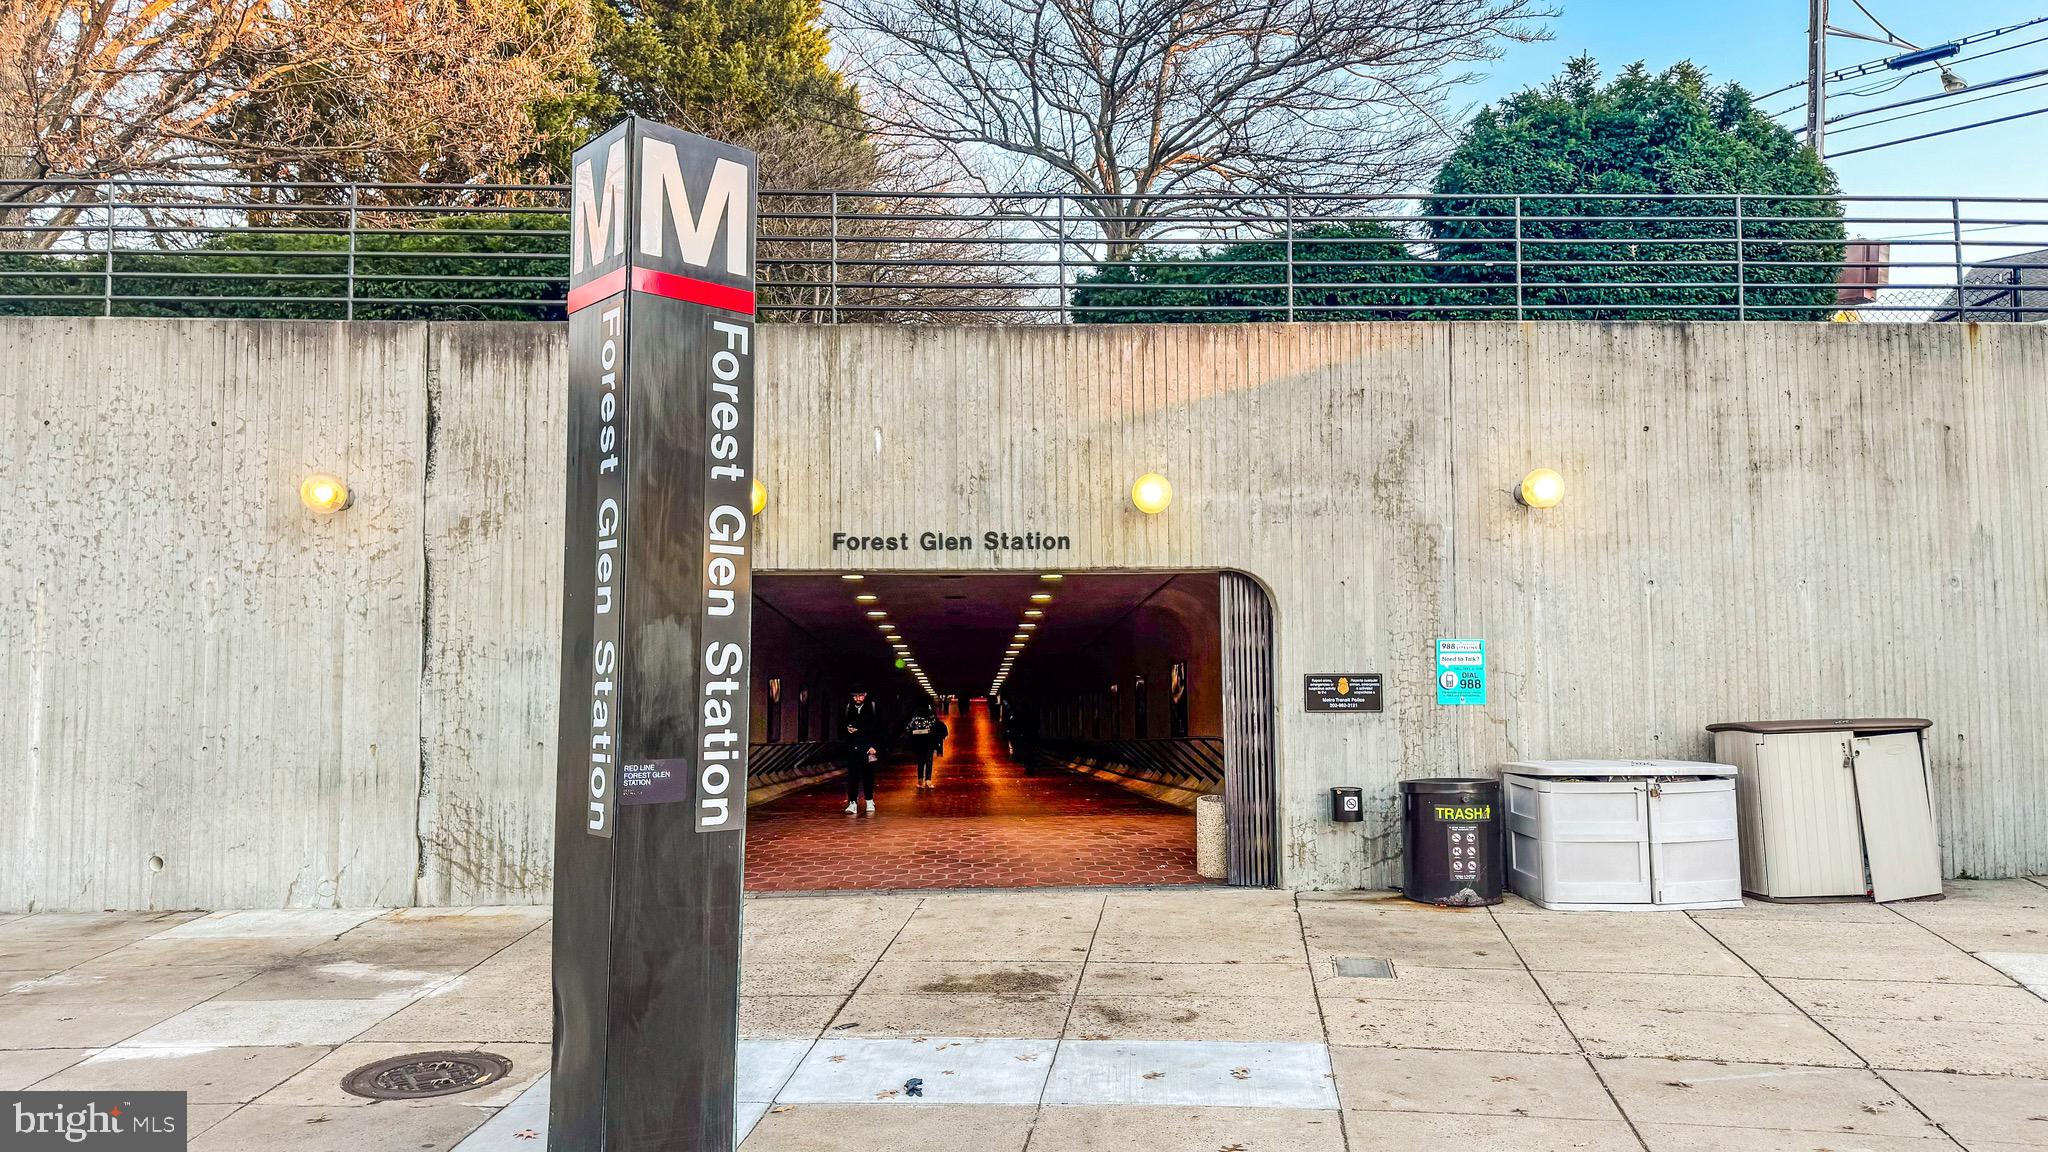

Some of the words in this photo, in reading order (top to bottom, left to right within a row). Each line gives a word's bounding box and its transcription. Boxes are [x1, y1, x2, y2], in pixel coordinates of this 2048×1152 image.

[573, 136, 625, 276] M
[640, 136, 748, 276] M
[599, 306, 620, 475] Forest
[711, 320, 748, 481] Forest
[596, 498, 619, 614] Glen
[707, 504, 746, 616] Glen
[832, 532, 909, 550] Forest
[919, 531, 973, 550] Glen
[984, 531, 1071, 550] Station
[1441, 642, 1456, 650] 988
[1460, 679, 1481, 689] 988
[1461, 671, 1479, 679] DIAL
[589, 639, 615, 831] Station
[701, 641, 743, 826] Station
[1435, 808, 1482, 819] TRASH
